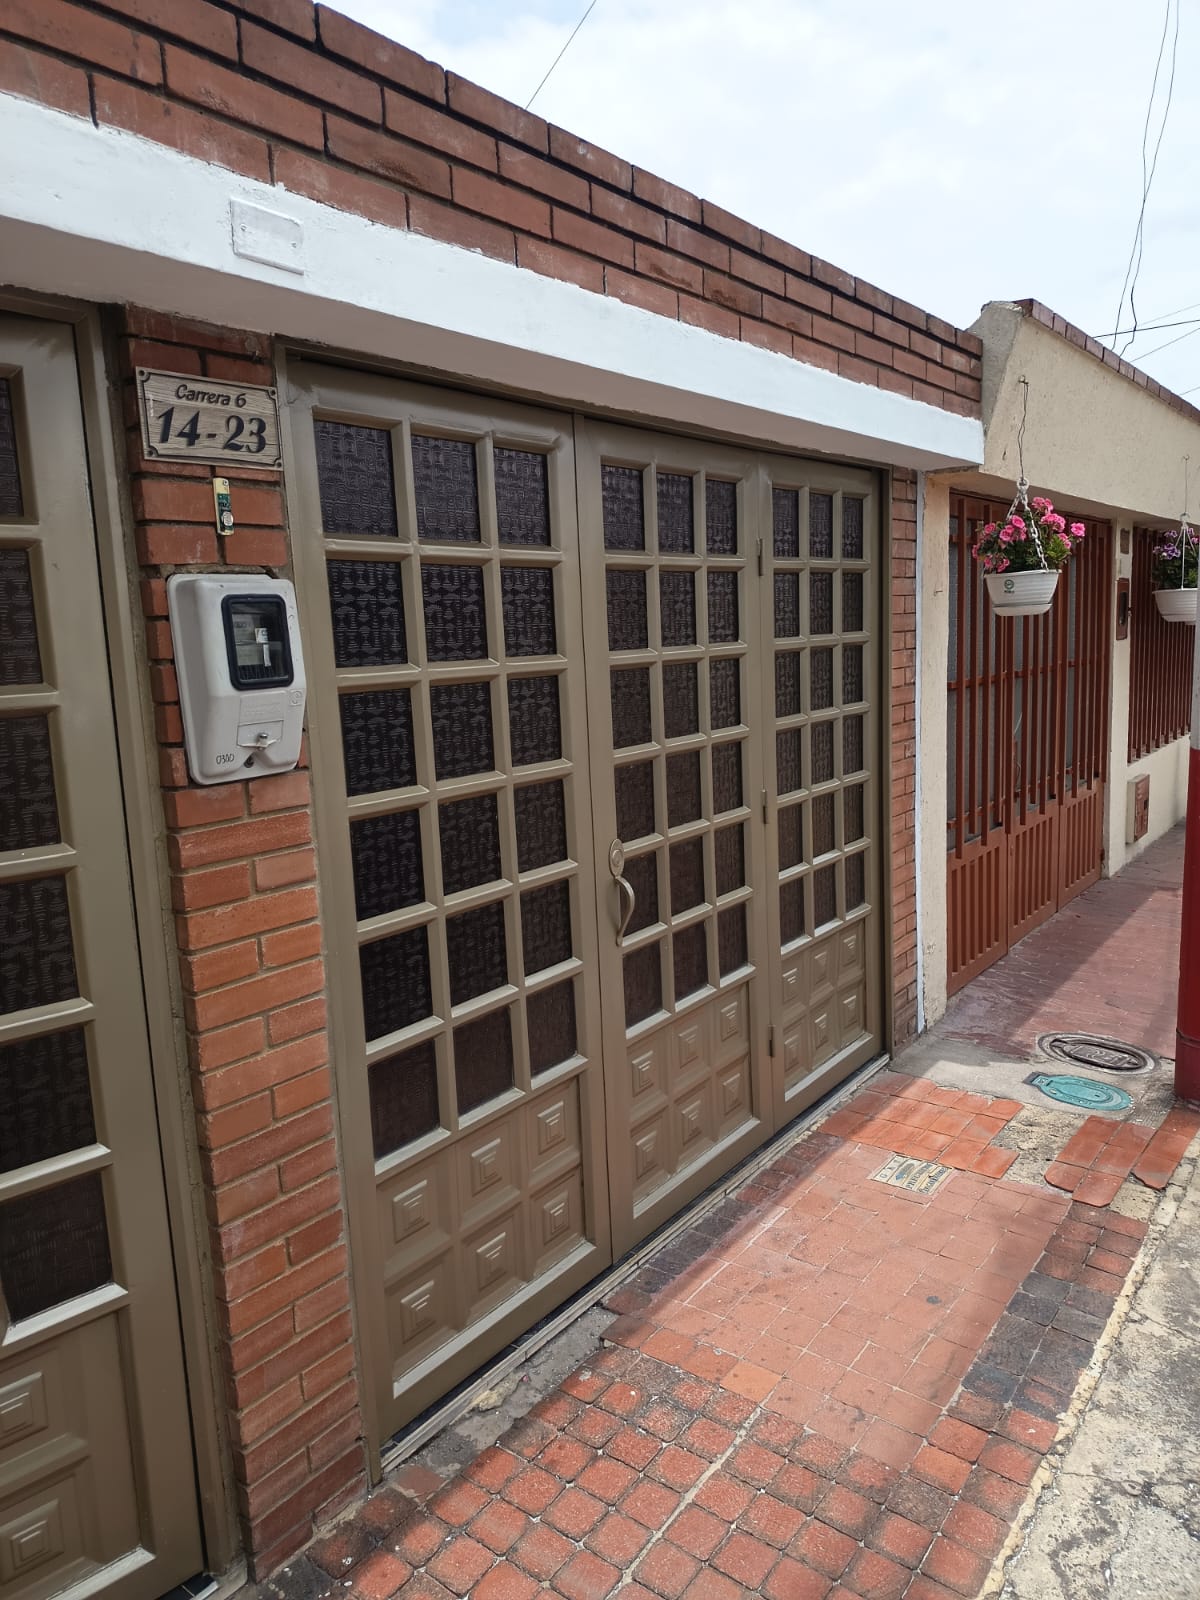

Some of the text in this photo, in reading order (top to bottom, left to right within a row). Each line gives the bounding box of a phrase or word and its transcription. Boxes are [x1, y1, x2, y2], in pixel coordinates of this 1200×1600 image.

[175, 384, 247, 408] Carrera 6
[157, 406, 267, 454] 14-23
